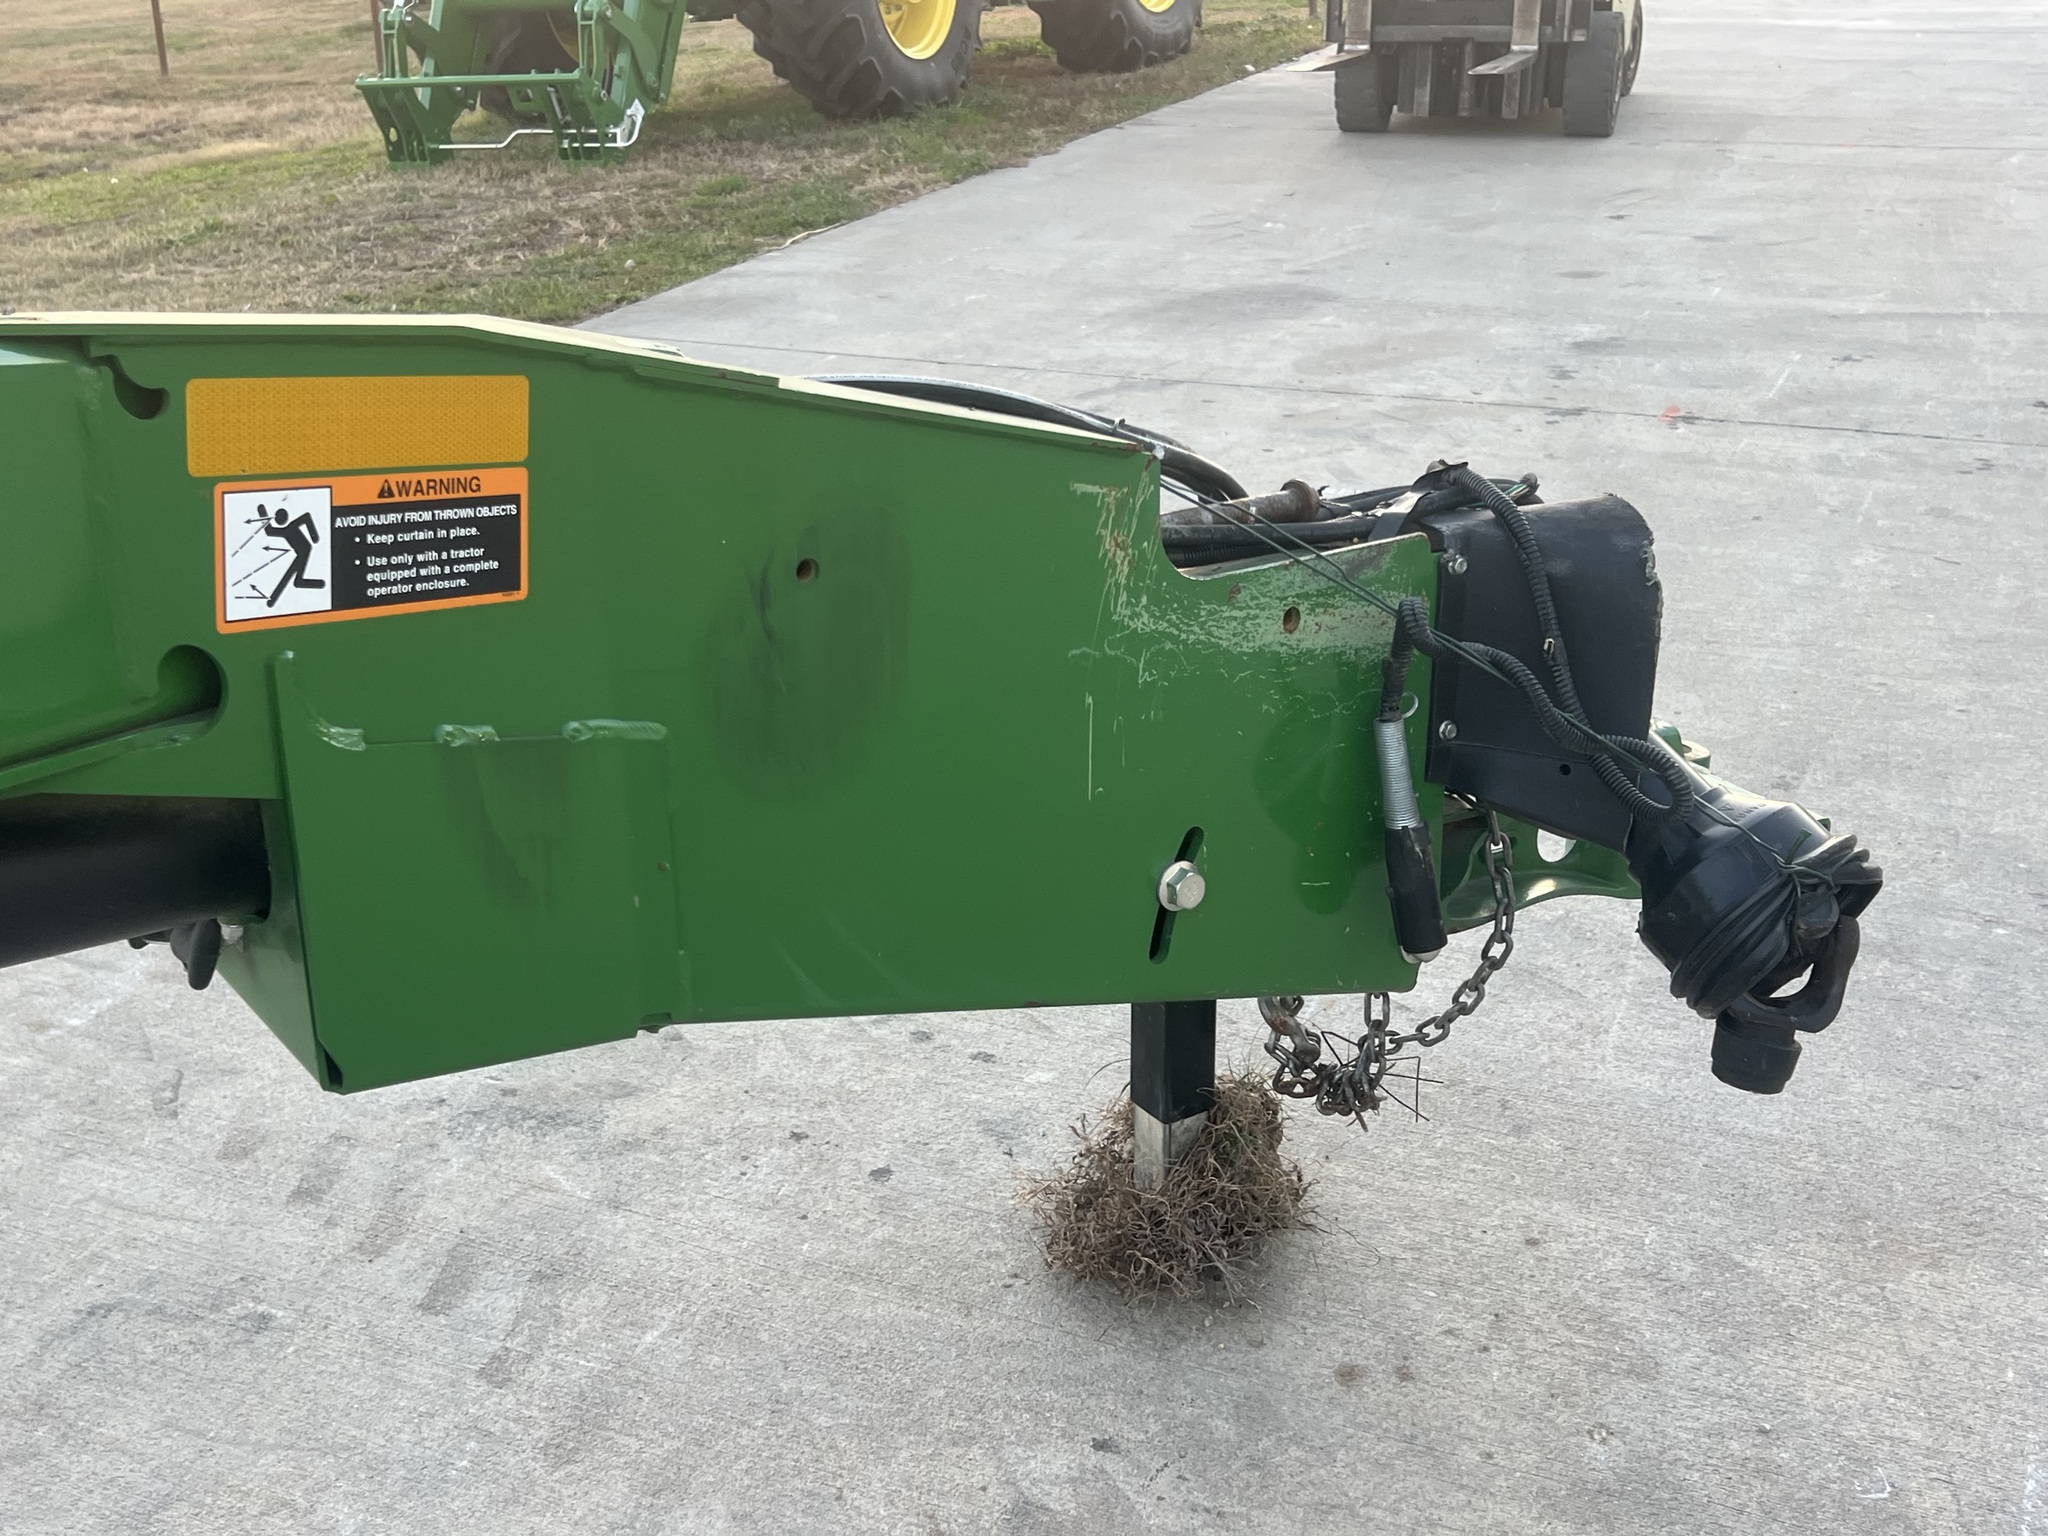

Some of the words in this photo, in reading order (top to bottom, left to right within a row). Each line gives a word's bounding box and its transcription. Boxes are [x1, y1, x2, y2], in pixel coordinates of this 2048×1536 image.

[395, 476, 481, 497] WARNING
[335, 515, 366, 528] AVOID
[368, 513, 403, 526] INJURY
[404, 510, 432, 523] FROM
[434, 508, 474, 521] THROWN
[476, 505, 517, 518] OBJECTS
[366, 533, 394, 545] Keep
[397, 529, 434, 542] curtain
[437, 528, 447, 538] in
[450, 526, 480, 539] place.
[367, 556, 388, 566] Use
[390, 553, 414, 565] only
[416, 550, 439, 562] with
[441, 551, 448, 560] a
[450, 548, 485, 559] tractor
[366, 567, 416, 583] equipped
[419, 565, 441, 576] with
[444, 566, 450, 574] a
[453, 560, 499, 573] complete
[367, 584, 413, 598] operator
[415, 578, 470, 592] enclosure.
